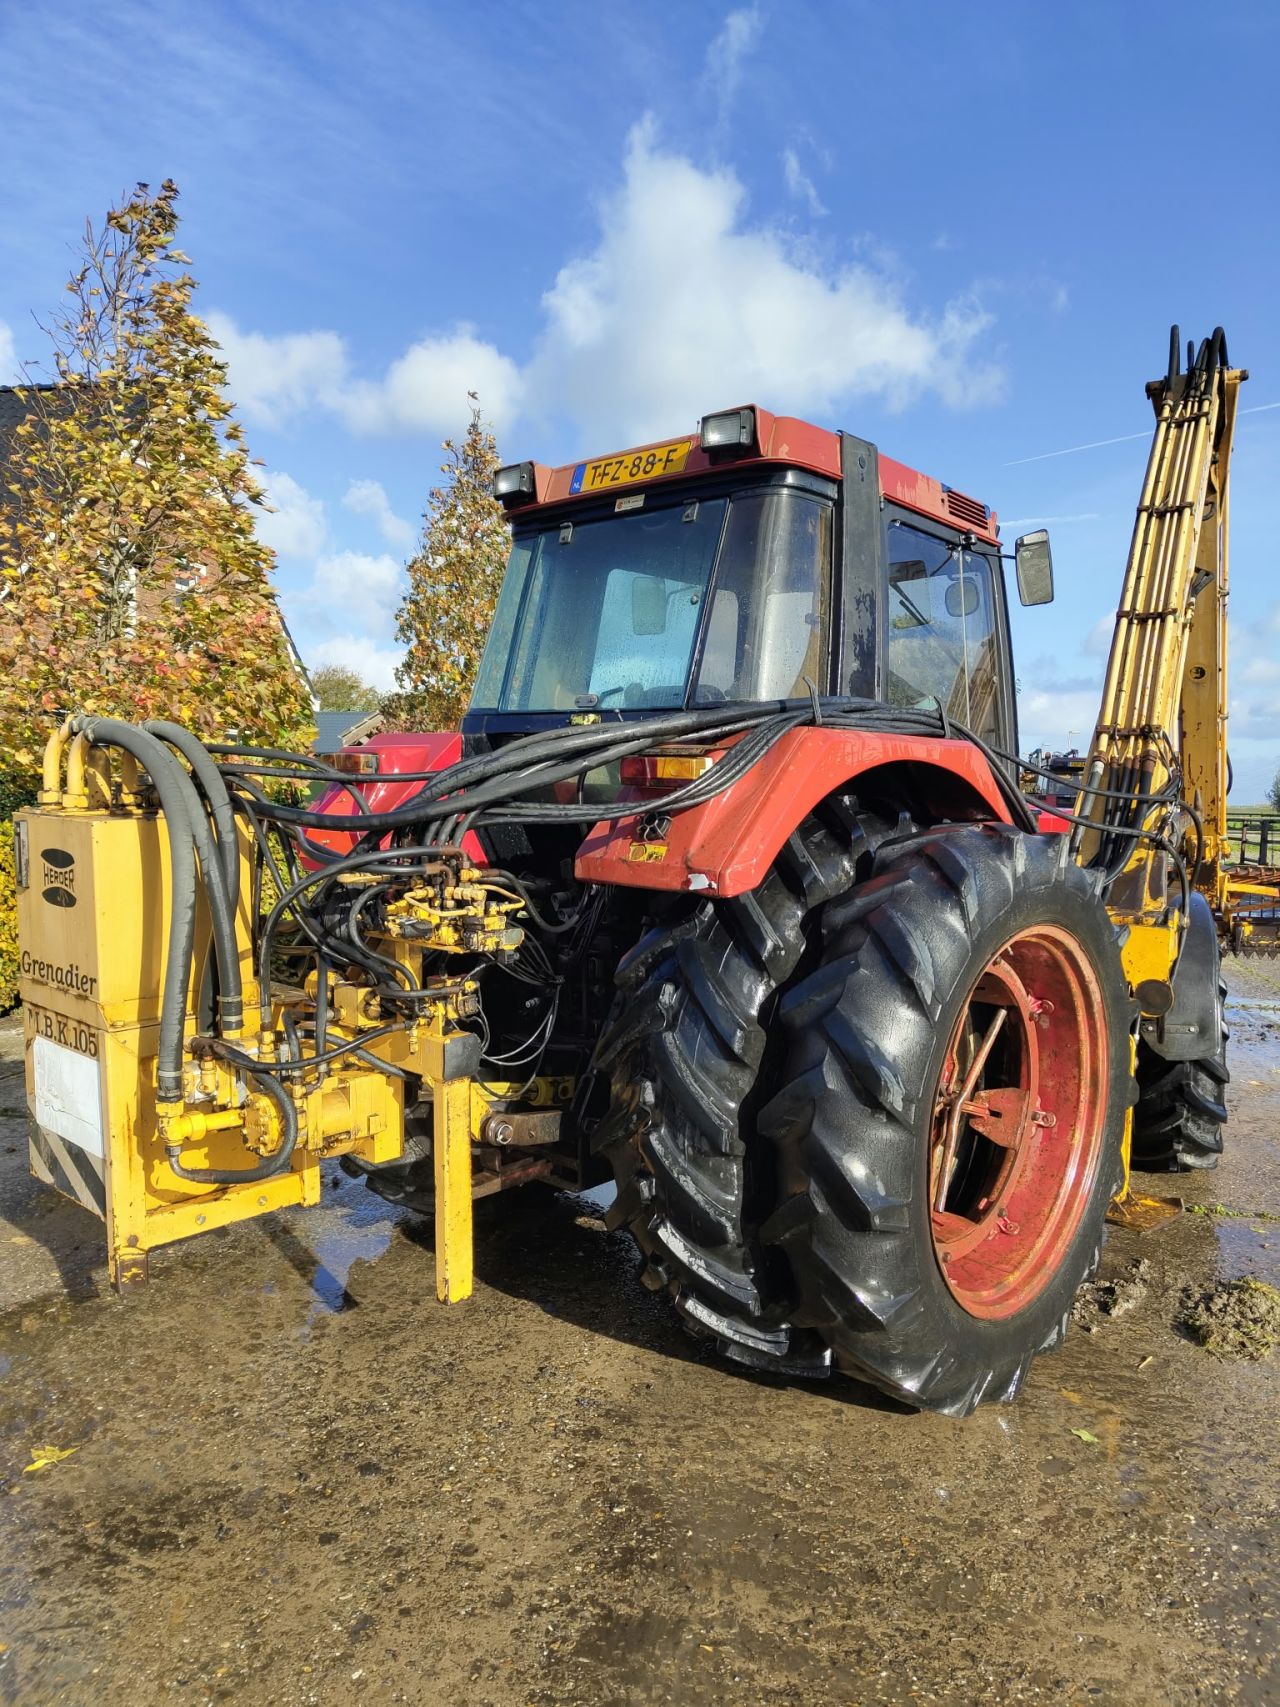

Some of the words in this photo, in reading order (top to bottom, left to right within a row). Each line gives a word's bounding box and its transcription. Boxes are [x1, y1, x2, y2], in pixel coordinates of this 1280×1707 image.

[591, 448, 678, 486] TFZ-88-F
[43, 862, 75, 893] HERDER
[22, 950, 97, 995] Grenadier
